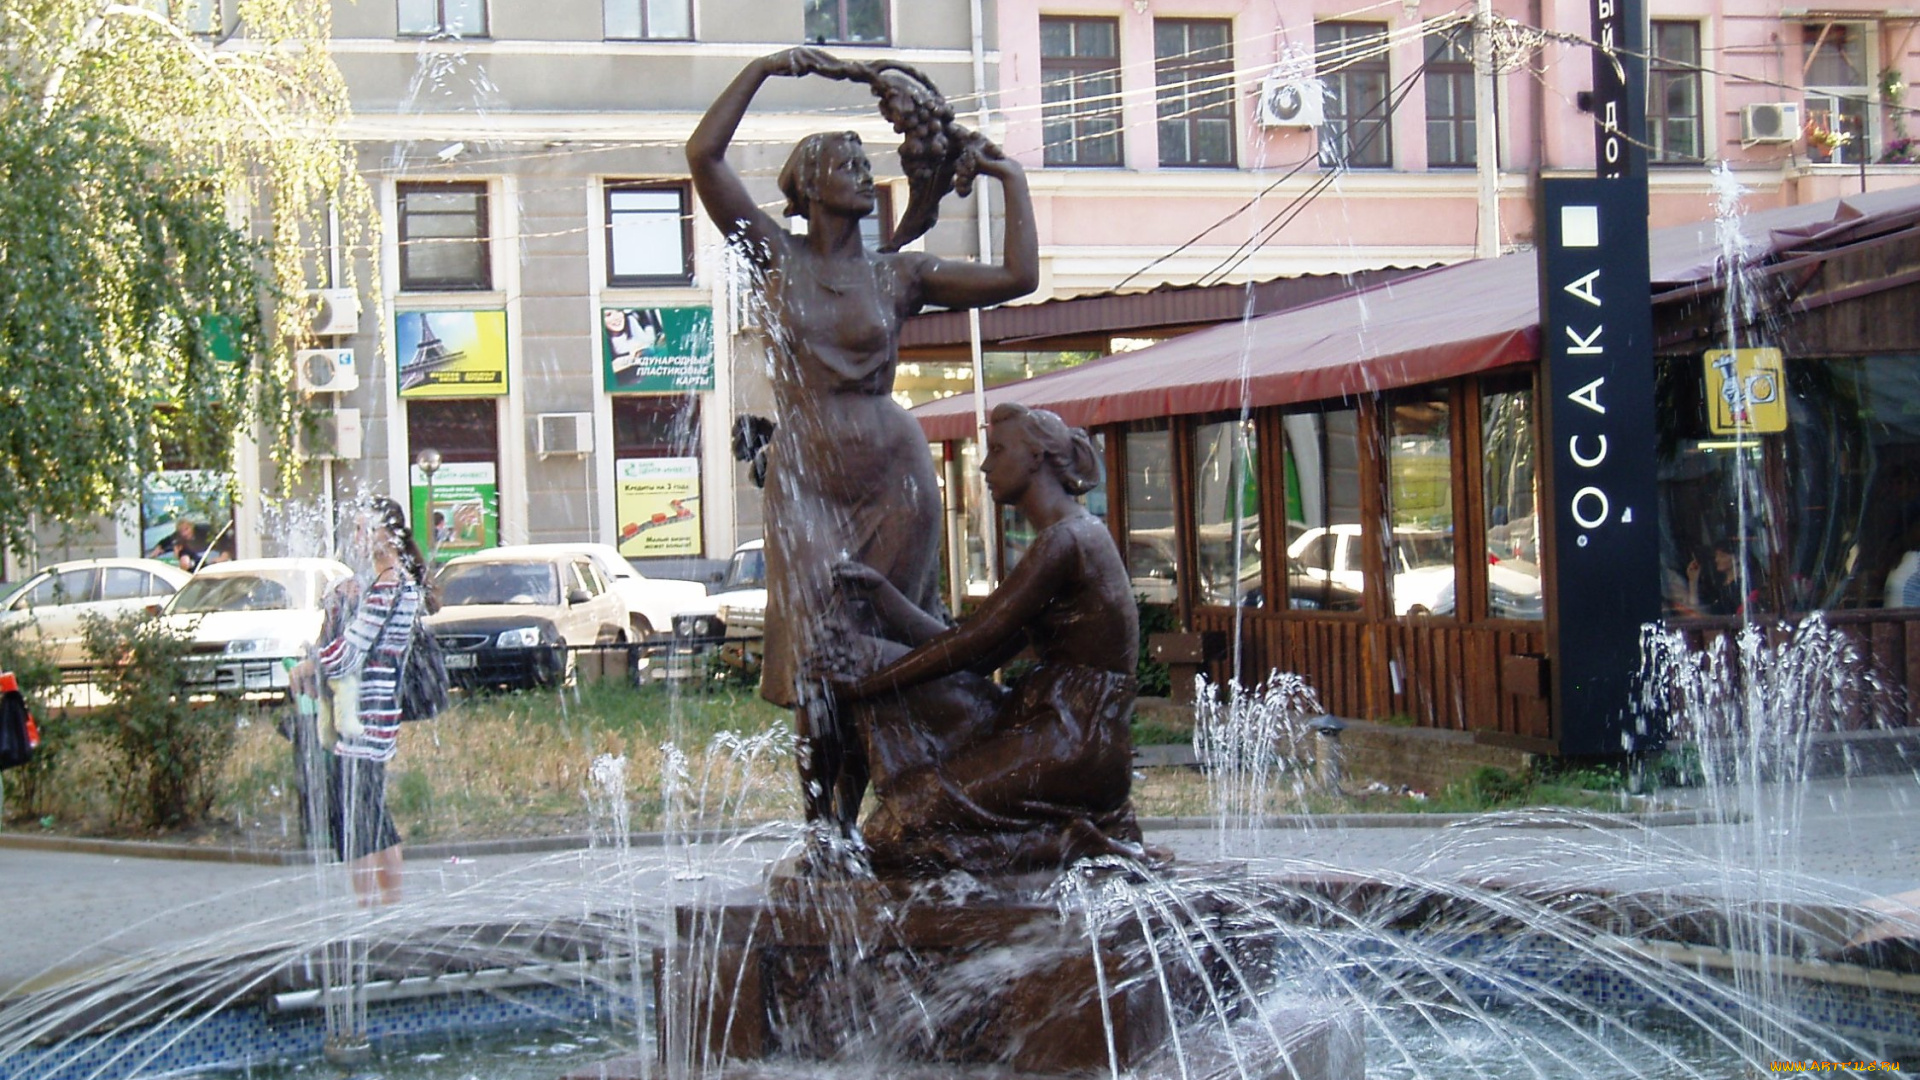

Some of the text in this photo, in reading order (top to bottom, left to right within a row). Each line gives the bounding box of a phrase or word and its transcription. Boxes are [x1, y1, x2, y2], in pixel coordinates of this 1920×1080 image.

[1604, 101, 1620, 178] ДО
[627, 356, 708, 366] ЖДУНАРОДНЫЕ
[636, 366, 709, 376] ПЛАСТИКОВЫЕ
[675, 376, 710, 385] КАРТЫ
[1563, 269, 1609, 529] ОСАКА
